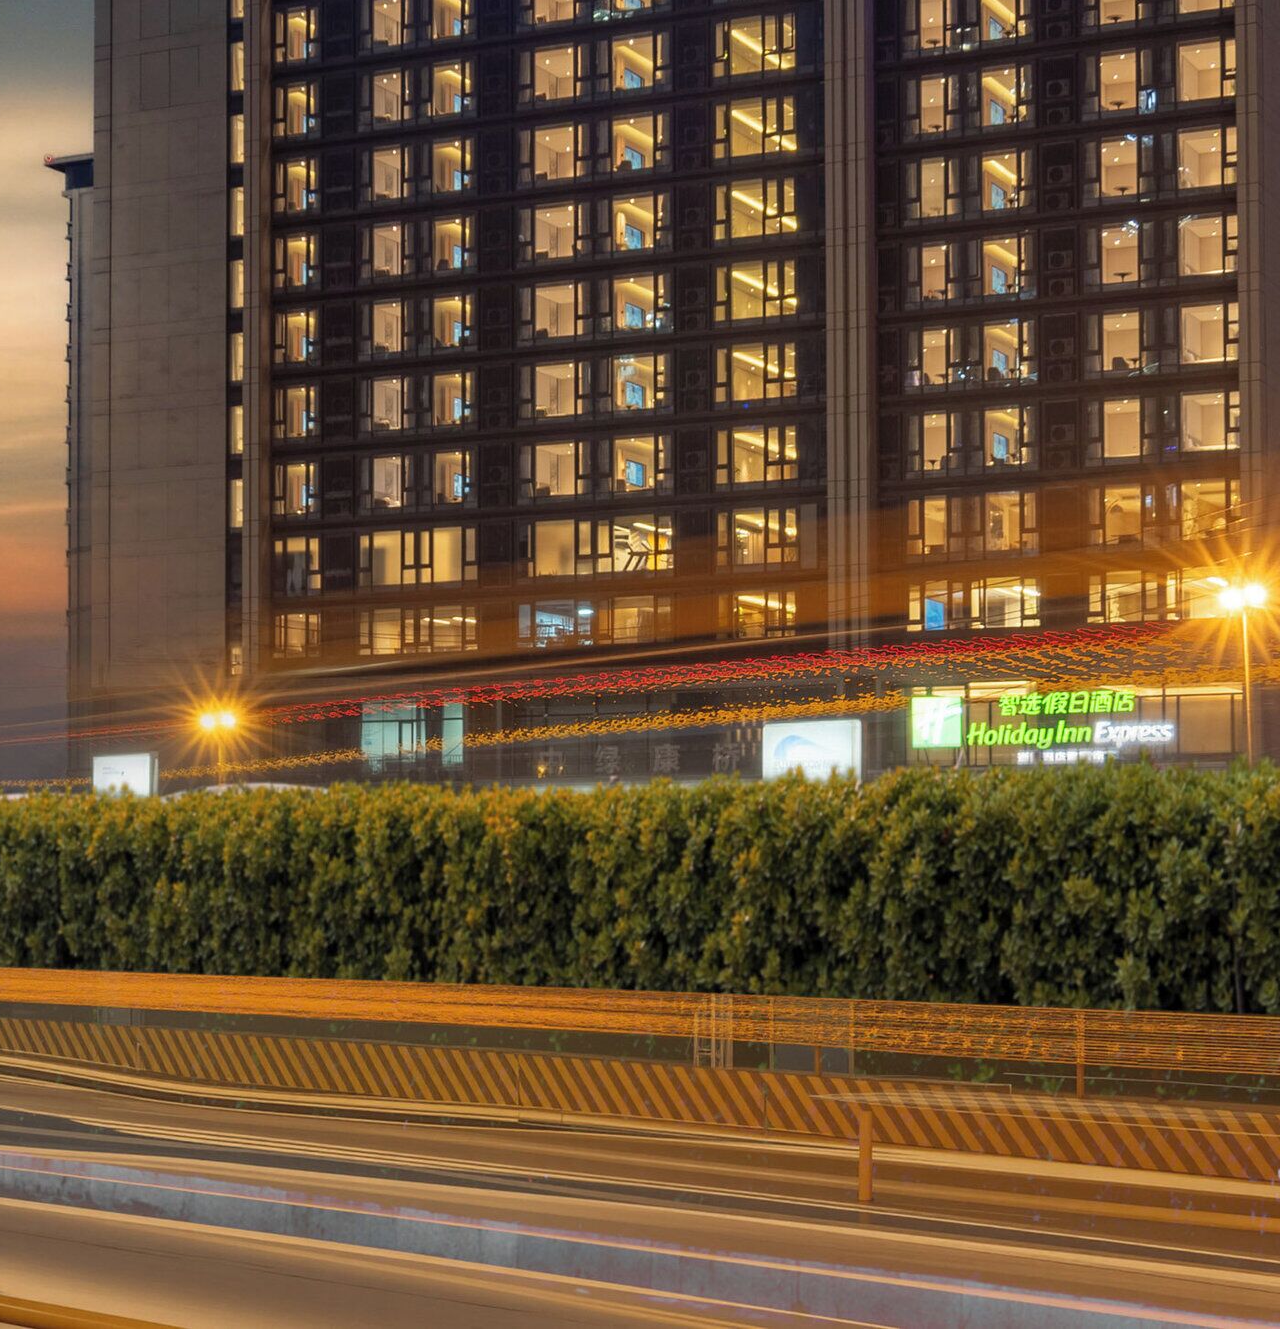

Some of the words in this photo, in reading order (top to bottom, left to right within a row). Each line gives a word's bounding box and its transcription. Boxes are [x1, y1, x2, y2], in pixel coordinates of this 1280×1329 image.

[998, 689, 1136, 717] 智选假日酒店
[966, 721, 1055, 750] Holiday
[1055, 719, 1093, 743] Inn
[1093, 720, 1176, 748] Express
